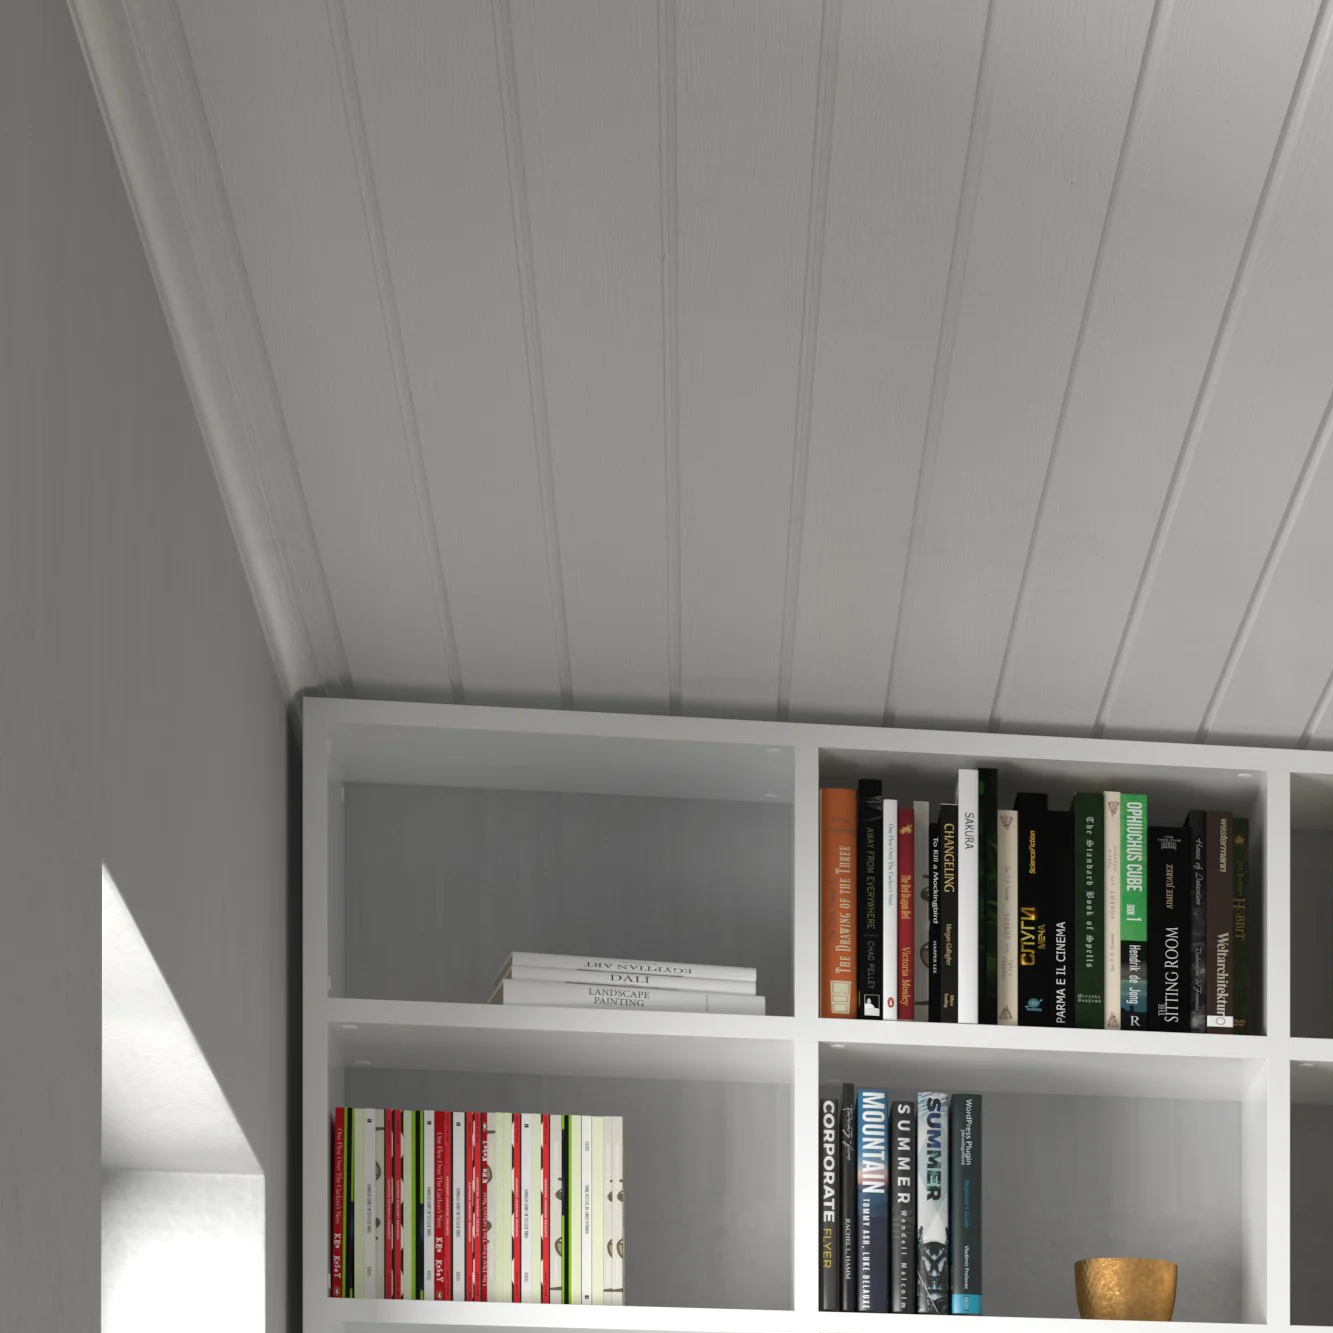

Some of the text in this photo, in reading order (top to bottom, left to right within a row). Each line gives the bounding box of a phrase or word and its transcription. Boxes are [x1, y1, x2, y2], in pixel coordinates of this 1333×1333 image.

[932, 836, 940, 846] To
[932, 848, 940, 862] Kill
[944, 822, 955, 893] CHANGELING
[964, 811, 975, 850] SAKURA
[1127, 801, 1143, 892] OPHIUCHUS CUBE
[1219, 818, 1228, 872] westermann
[866, 827, 875, 929] AWAY FROM EVERYWHERE
[932, 872, 940, 924] Mockingbird
[588, 986, 651, 1000] LANDSCAPE
[1127, 944, 1141, 1004] Hendrik de Jong
[1165, 926, 1179, 1022] SITTING ROOM
[823, 1099, 835, 1223] CORPORATE
[862, 1091, 885, 1194] MOUNTAIN
[926, 1097, 942, 1201] SUMMER
